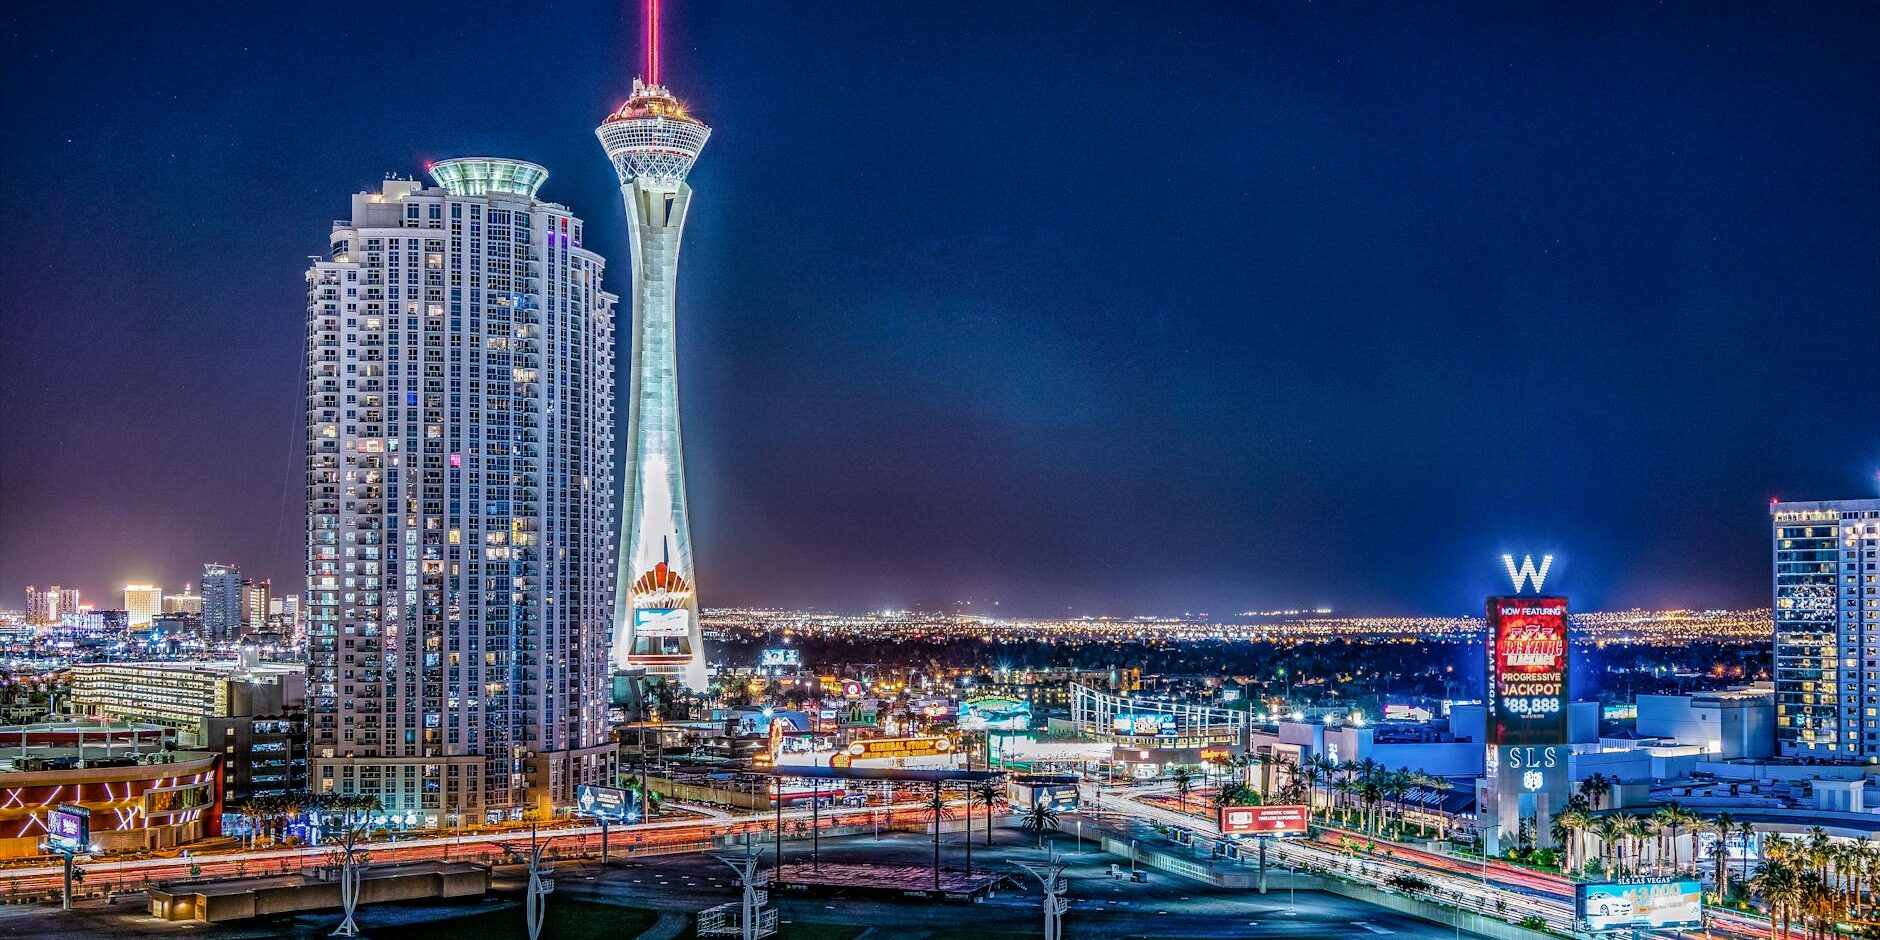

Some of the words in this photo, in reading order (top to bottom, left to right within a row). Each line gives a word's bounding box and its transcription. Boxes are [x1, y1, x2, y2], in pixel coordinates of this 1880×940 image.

[1503, 554, 1553, 593] W
[1502, 607, 1520, 616] NOW
[1522, 607, 1561, 616] FEATURING
[1502, 672, 1561, 682] PROGRESSIVE
[1501, 683, 1562, 696] JACKPOT
[1504, 697, 1559, 714] $88,888
[870, 741, 905, 752] GENERAL
[1509, 747, 1557, 768] SLS
[1632, 877, 1646, 885] LAS
[1647, 876, 1671, 884] VEGAS
